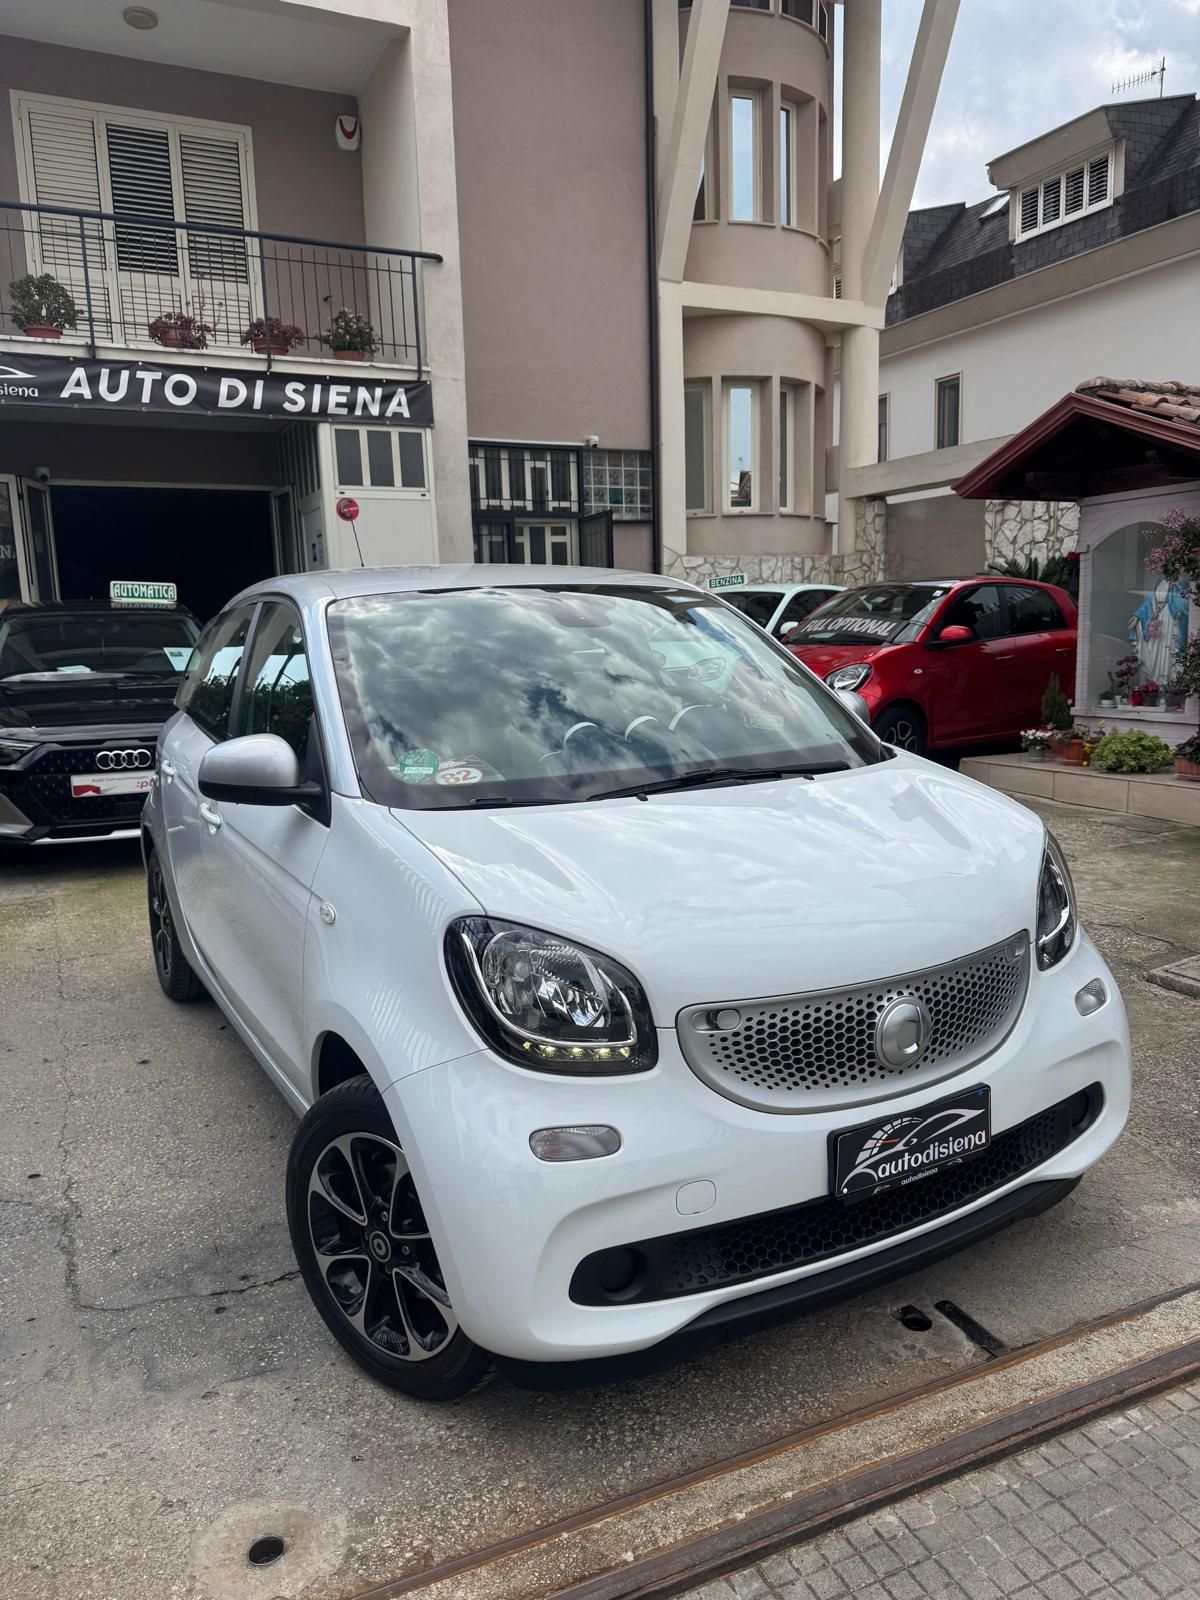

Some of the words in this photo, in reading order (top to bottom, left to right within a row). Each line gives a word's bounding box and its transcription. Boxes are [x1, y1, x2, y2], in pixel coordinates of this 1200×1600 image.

[59, 366, 198, 406] AUTO
[217, 377, 265, 410] DI
[282, 381, 411, 418] SIENA
[114, 583, 175, 599] AUTOMATICA
[710, 576, 742, 588] BENZINA
[800, 617, 833, 633] FULL
[827, 616, 897, 637] OPTIONAL
[877, 1129, 986, 1179] autodisiena
[901, 1167, 938, 1185] autodisiena
